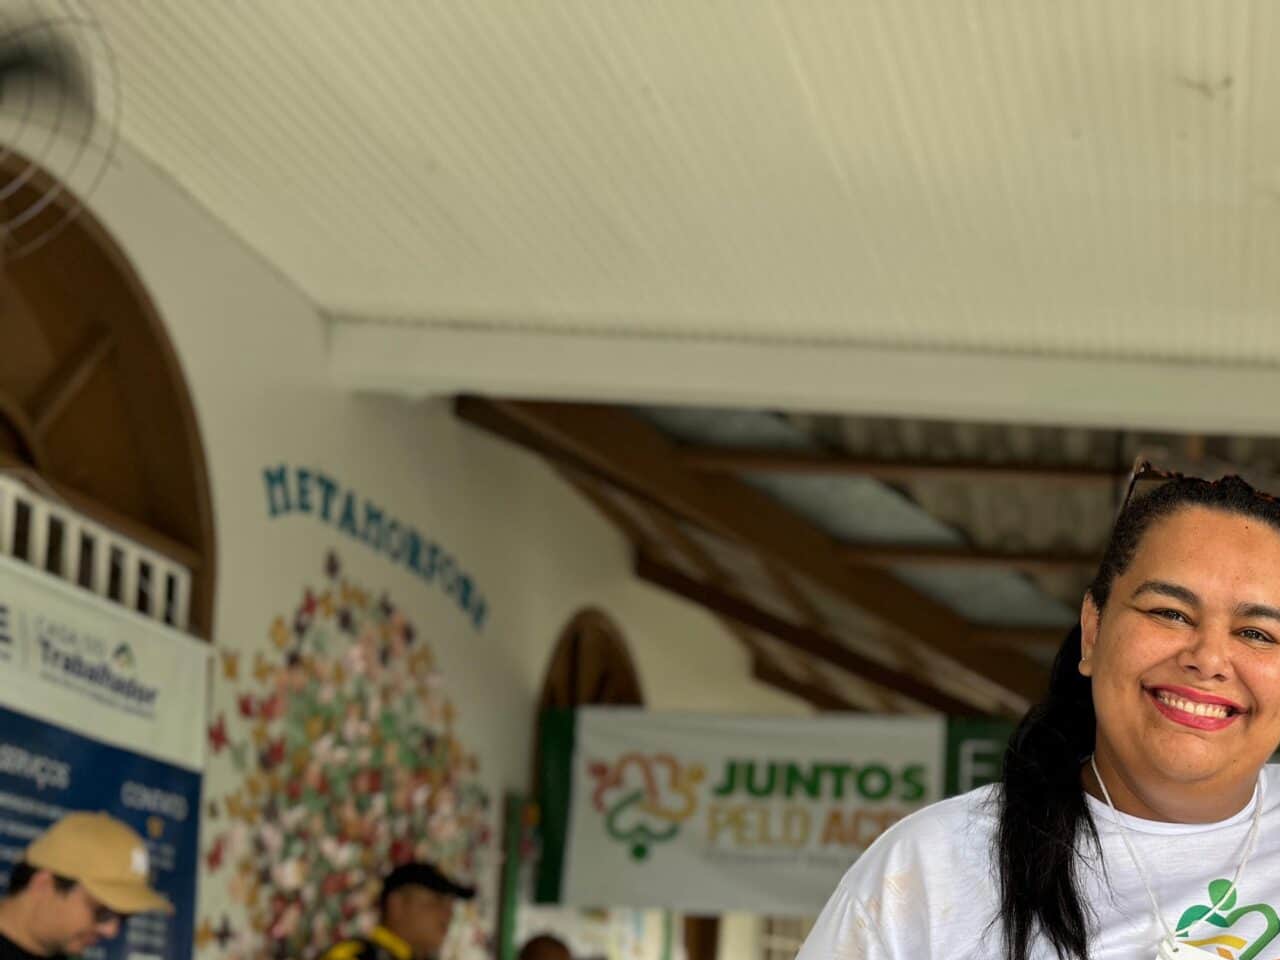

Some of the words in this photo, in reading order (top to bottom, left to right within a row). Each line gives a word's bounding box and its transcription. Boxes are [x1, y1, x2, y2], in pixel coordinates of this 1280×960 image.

[713, 758, 926, 801] JUNTOS
[706, 802, 808, 846] PELO
[818, 808, 908, 850] AC
